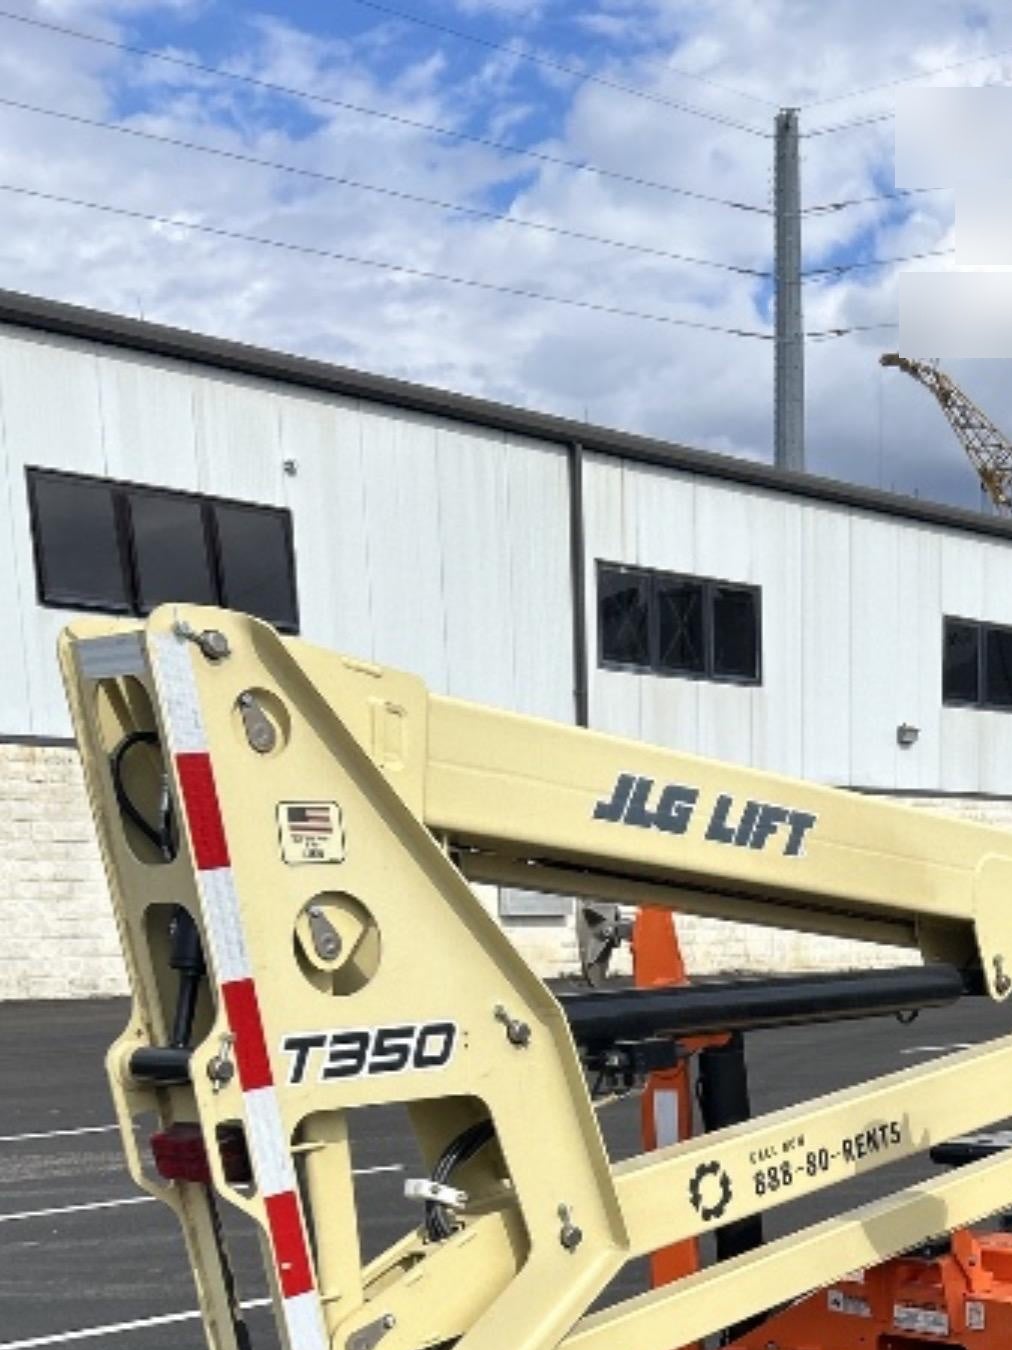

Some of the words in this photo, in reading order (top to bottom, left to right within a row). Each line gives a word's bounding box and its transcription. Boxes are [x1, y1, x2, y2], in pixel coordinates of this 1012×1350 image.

[592, 773, 700, 835] JLG
[704, 794, 817, 856] LIFT
[283, 1022, 456, 1084] T350
